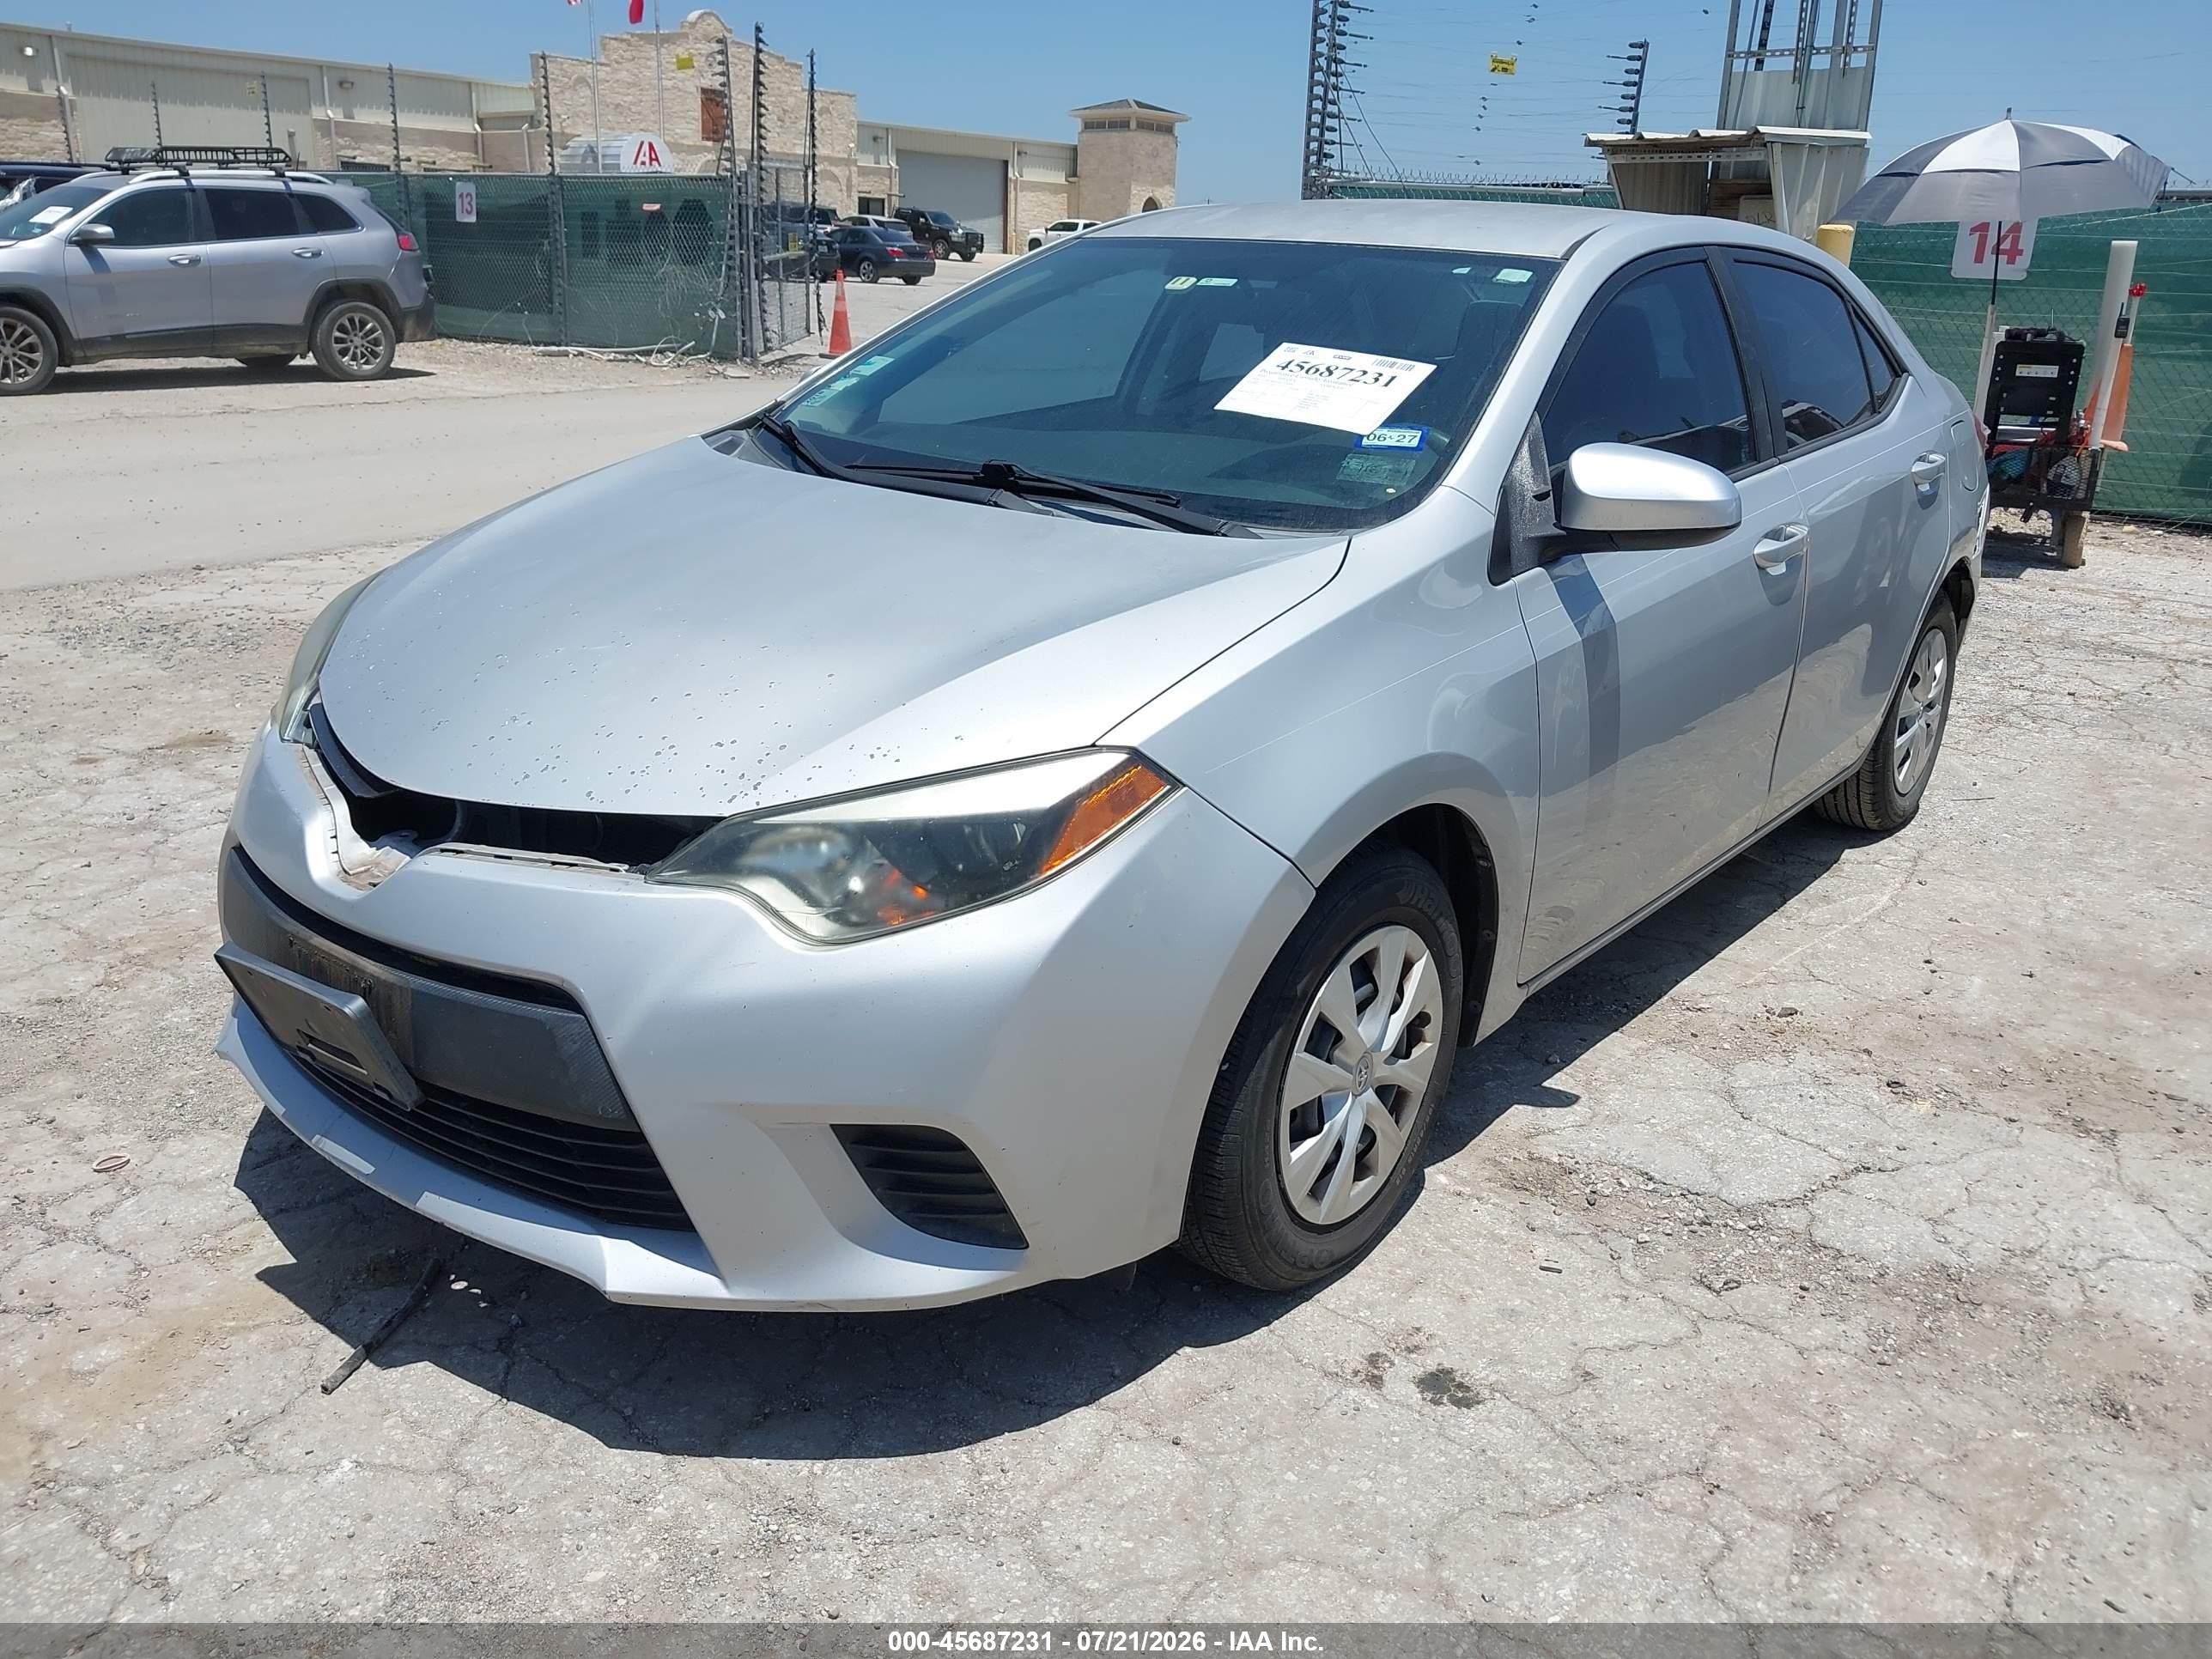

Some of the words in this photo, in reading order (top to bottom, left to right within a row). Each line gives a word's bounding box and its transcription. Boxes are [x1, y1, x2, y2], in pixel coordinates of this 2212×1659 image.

[459, 191, 473, 215] 13
[1969, 221, 2024, 265] 14
[1275, 358, 1399, 387] 45687231
[1366, 433, 1388, 442] 06
[1395, 434, 1419, 444] 27
